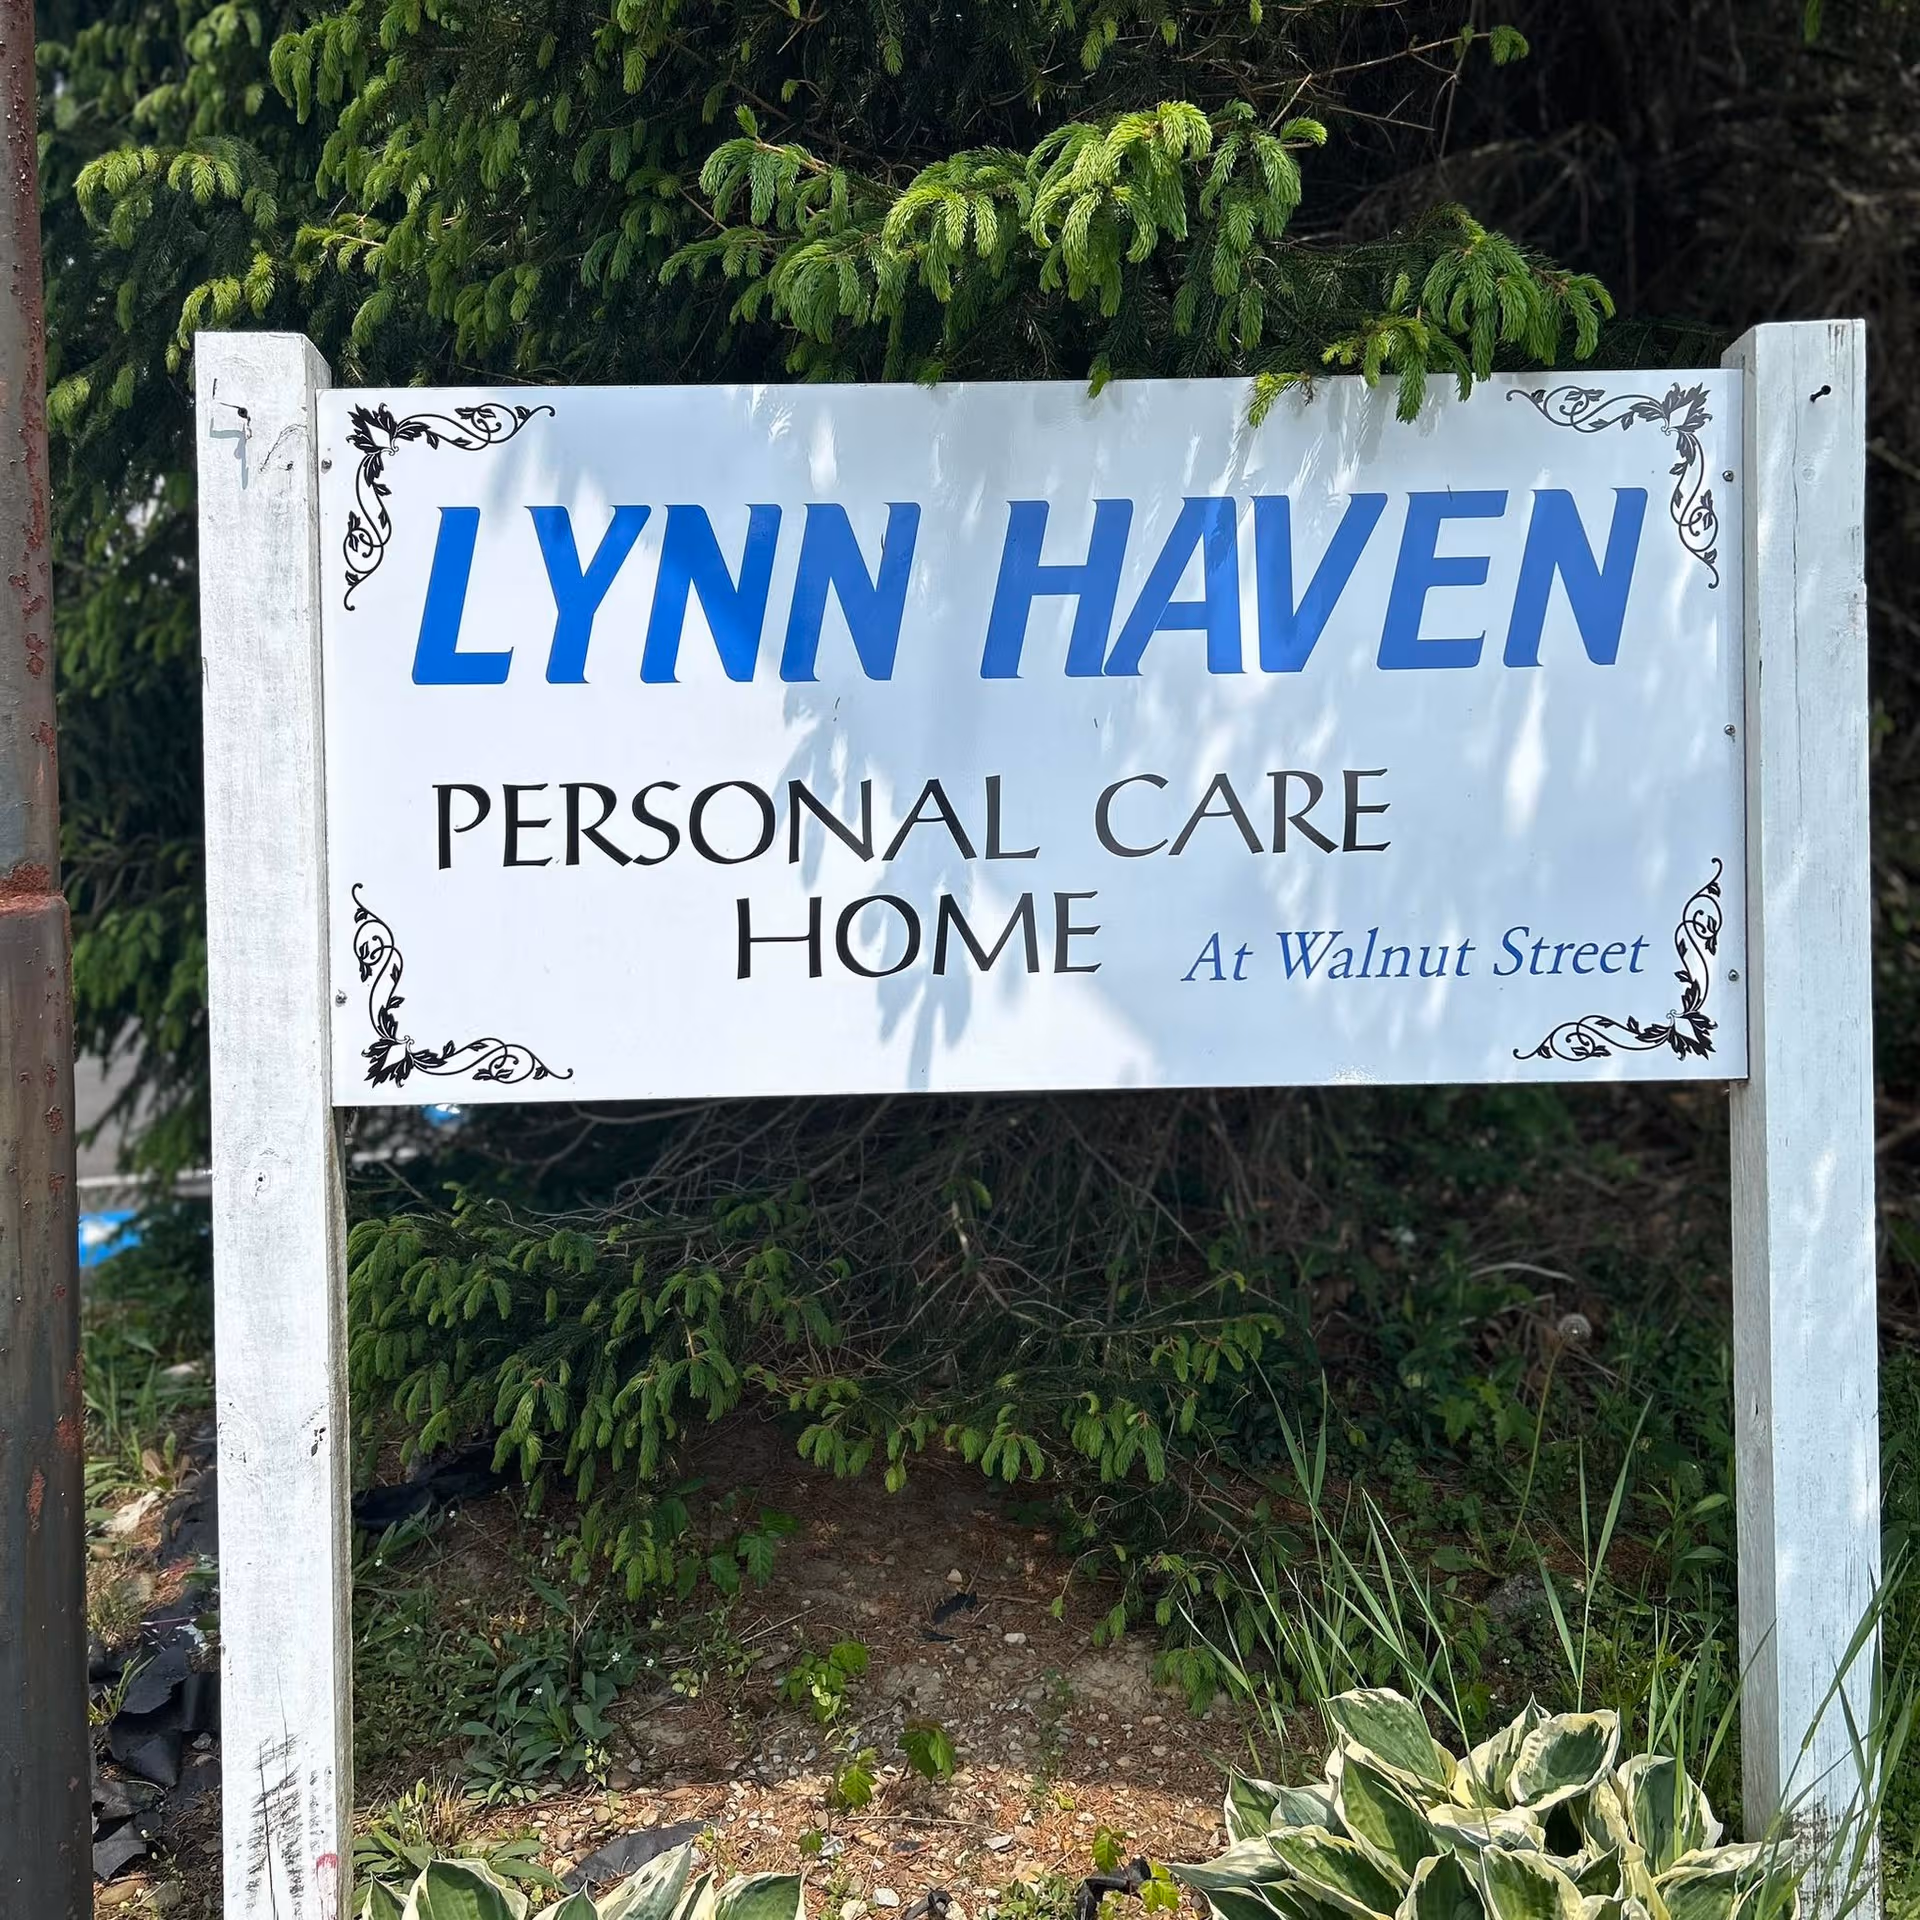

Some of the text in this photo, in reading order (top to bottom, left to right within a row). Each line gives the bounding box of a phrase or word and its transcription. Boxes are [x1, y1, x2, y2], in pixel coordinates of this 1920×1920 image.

[412, 487, 1648, 685] LYNN HAVEN
[432, 767, 1391, 870] PERSONAL CARE
[736, 889, 1102, 980] HOME
[1180, 925, 1651, 982] At Walnut Street
